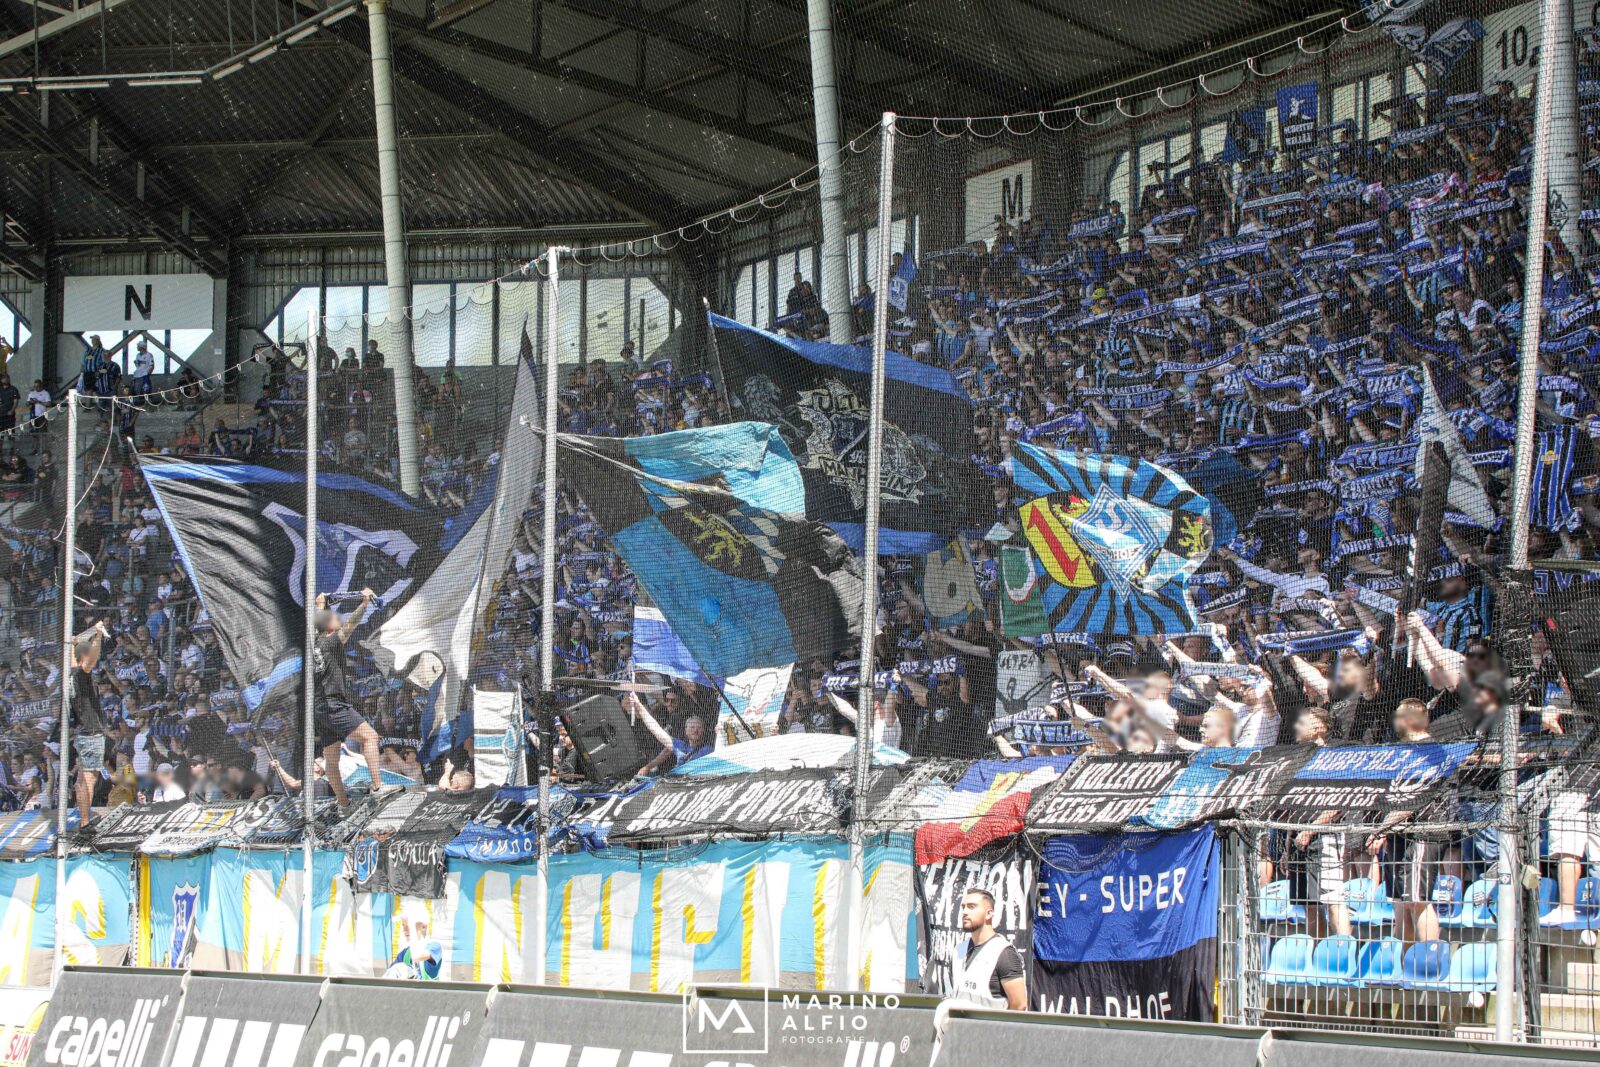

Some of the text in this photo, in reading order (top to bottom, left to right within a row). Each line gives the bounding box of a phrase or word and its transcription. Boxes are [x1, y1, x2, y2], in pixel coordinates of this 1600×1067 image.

[1001, 173, 1023, 219] M
[124, 284, 152, 321] N
[1101, 866, 1187, 914] SUPER
[44, 998, 160, 1067] capelli
